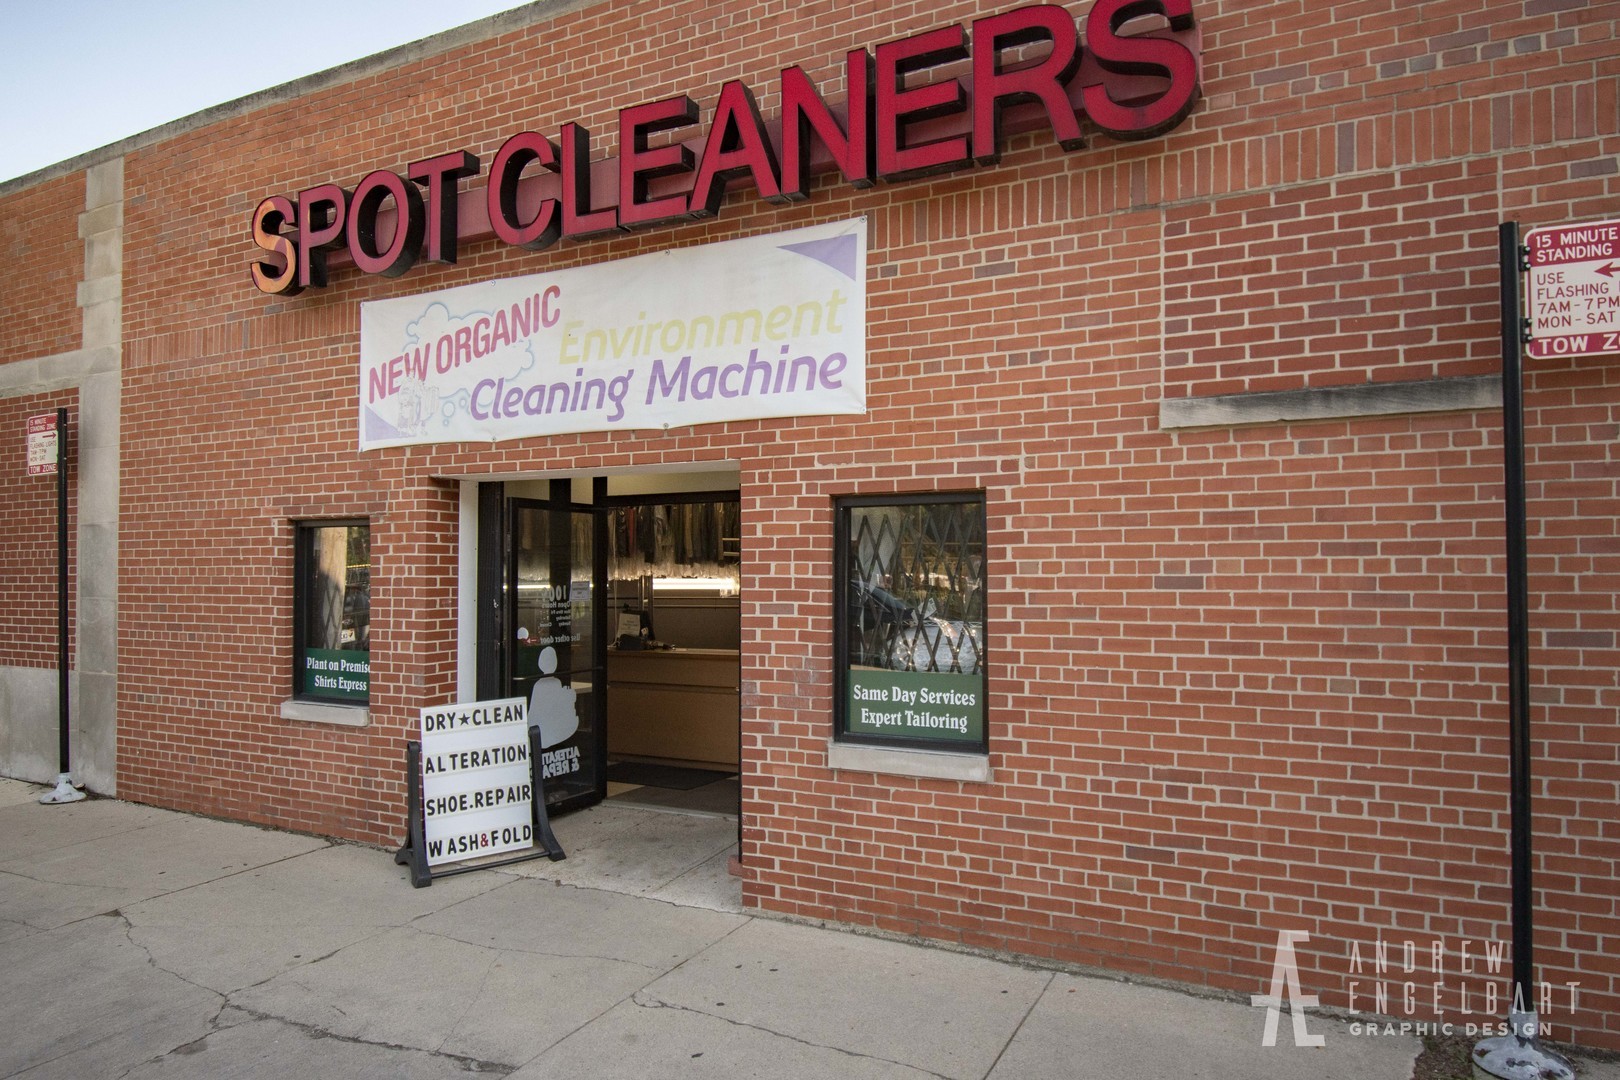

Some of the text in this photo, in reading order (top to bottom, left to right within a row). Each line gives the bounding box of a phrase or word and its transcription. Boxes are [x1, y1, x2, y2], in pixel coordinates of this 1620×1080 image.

[251, 0, 1202, 296] SPOT CLEANERS
[1536, 227, 1619, 248] 15 MINUTE
[1536, 243, 1613, 263] STANDING
[1537, 272, 1565, 285] USE
[1537, 282, 1609, 300] FLASHING
[559, 288, 848, 365] Environment
[369, 285, 561, 404] NEW ORGANIC
[1538, 335, 1589, 355] TOW
[470, 344, 848, 422] Cleaning Machine
[30, 464, 57, 474] TOW ZONE
[306, 657, 328, 670] Plant
[328, 661, 339, 671] on
[314, 675, 367, 692] Shirts Express
[853, 684, 976, 706] Same Day Services
[861, 708, 967, 733] Expert Tailoring
[425, 744, 527, 774] ALTERATION
